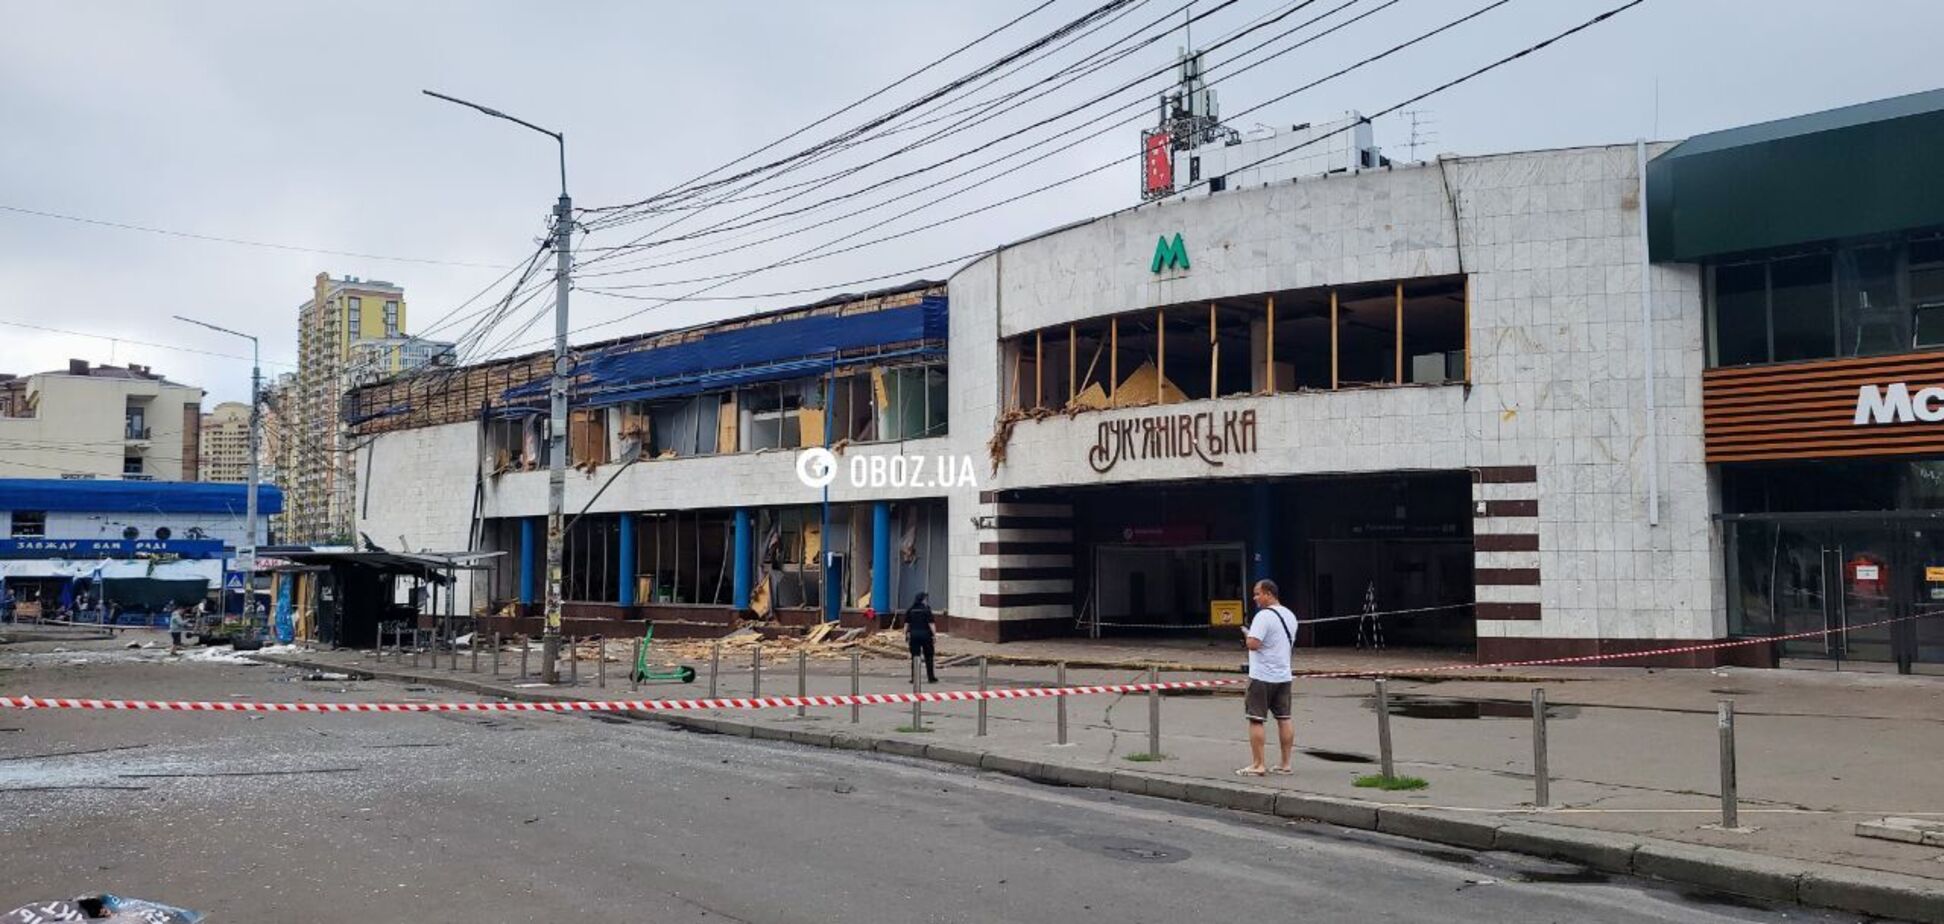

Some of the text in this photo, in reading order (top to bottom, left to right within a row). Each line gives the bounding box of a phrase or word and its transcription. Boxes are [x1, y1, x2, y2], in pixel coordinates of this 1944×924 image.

[1854, 382, 1944, 424] Mc
[93, 541, 121, 550] ВАМ
[136, 540, 167, 550] РАДІ
